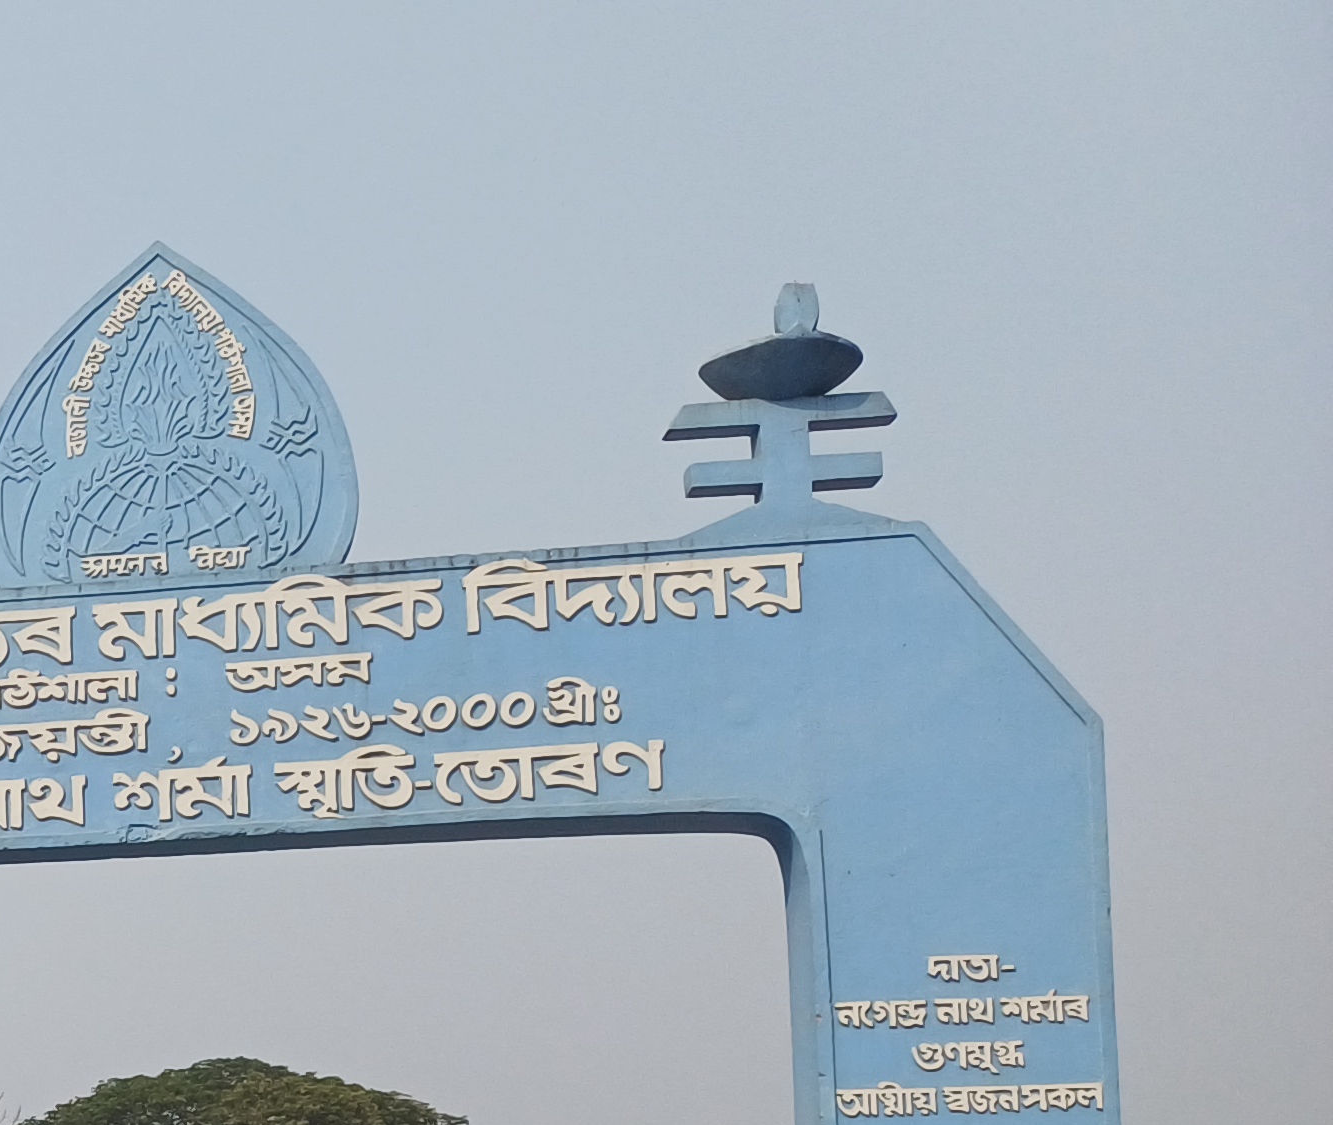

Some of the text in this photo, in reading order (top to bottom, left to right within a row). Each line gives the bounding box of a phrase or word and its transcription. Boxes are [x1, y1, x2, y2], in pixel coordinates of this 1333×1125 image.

[93, 575, 442, 657] মাধ্যমিক
[463, 553, 802, 633] বিদ্যালয়
[226, 652, 371, 690] অসম
[113, 757, 251, 820] শৰ্মা
[835, 989, 1089, 1027] নগেন্দ্ৰ নাথ শৰ্মাৰ
